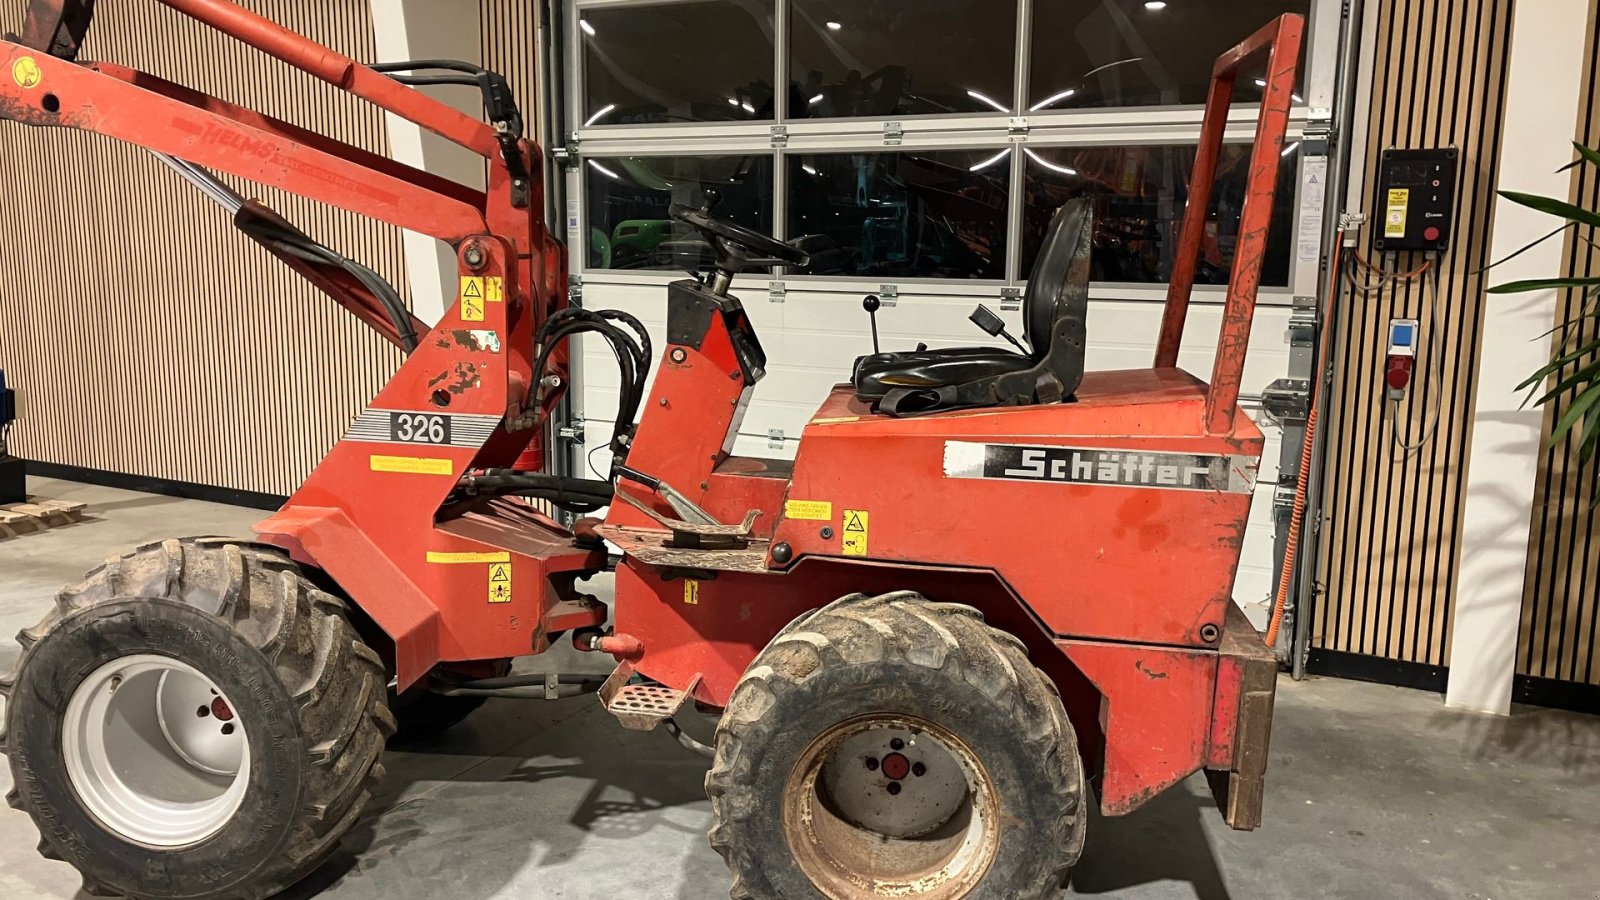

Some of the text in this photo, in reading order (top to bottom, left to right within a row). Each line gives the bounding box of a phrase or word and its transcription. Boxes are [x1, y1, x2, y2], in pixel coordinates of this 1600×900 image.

[201, 121, 276, 159] HELMS
[397, 413, 444, 443] 326
[1005, 450, 1209, 485] Schäffer
